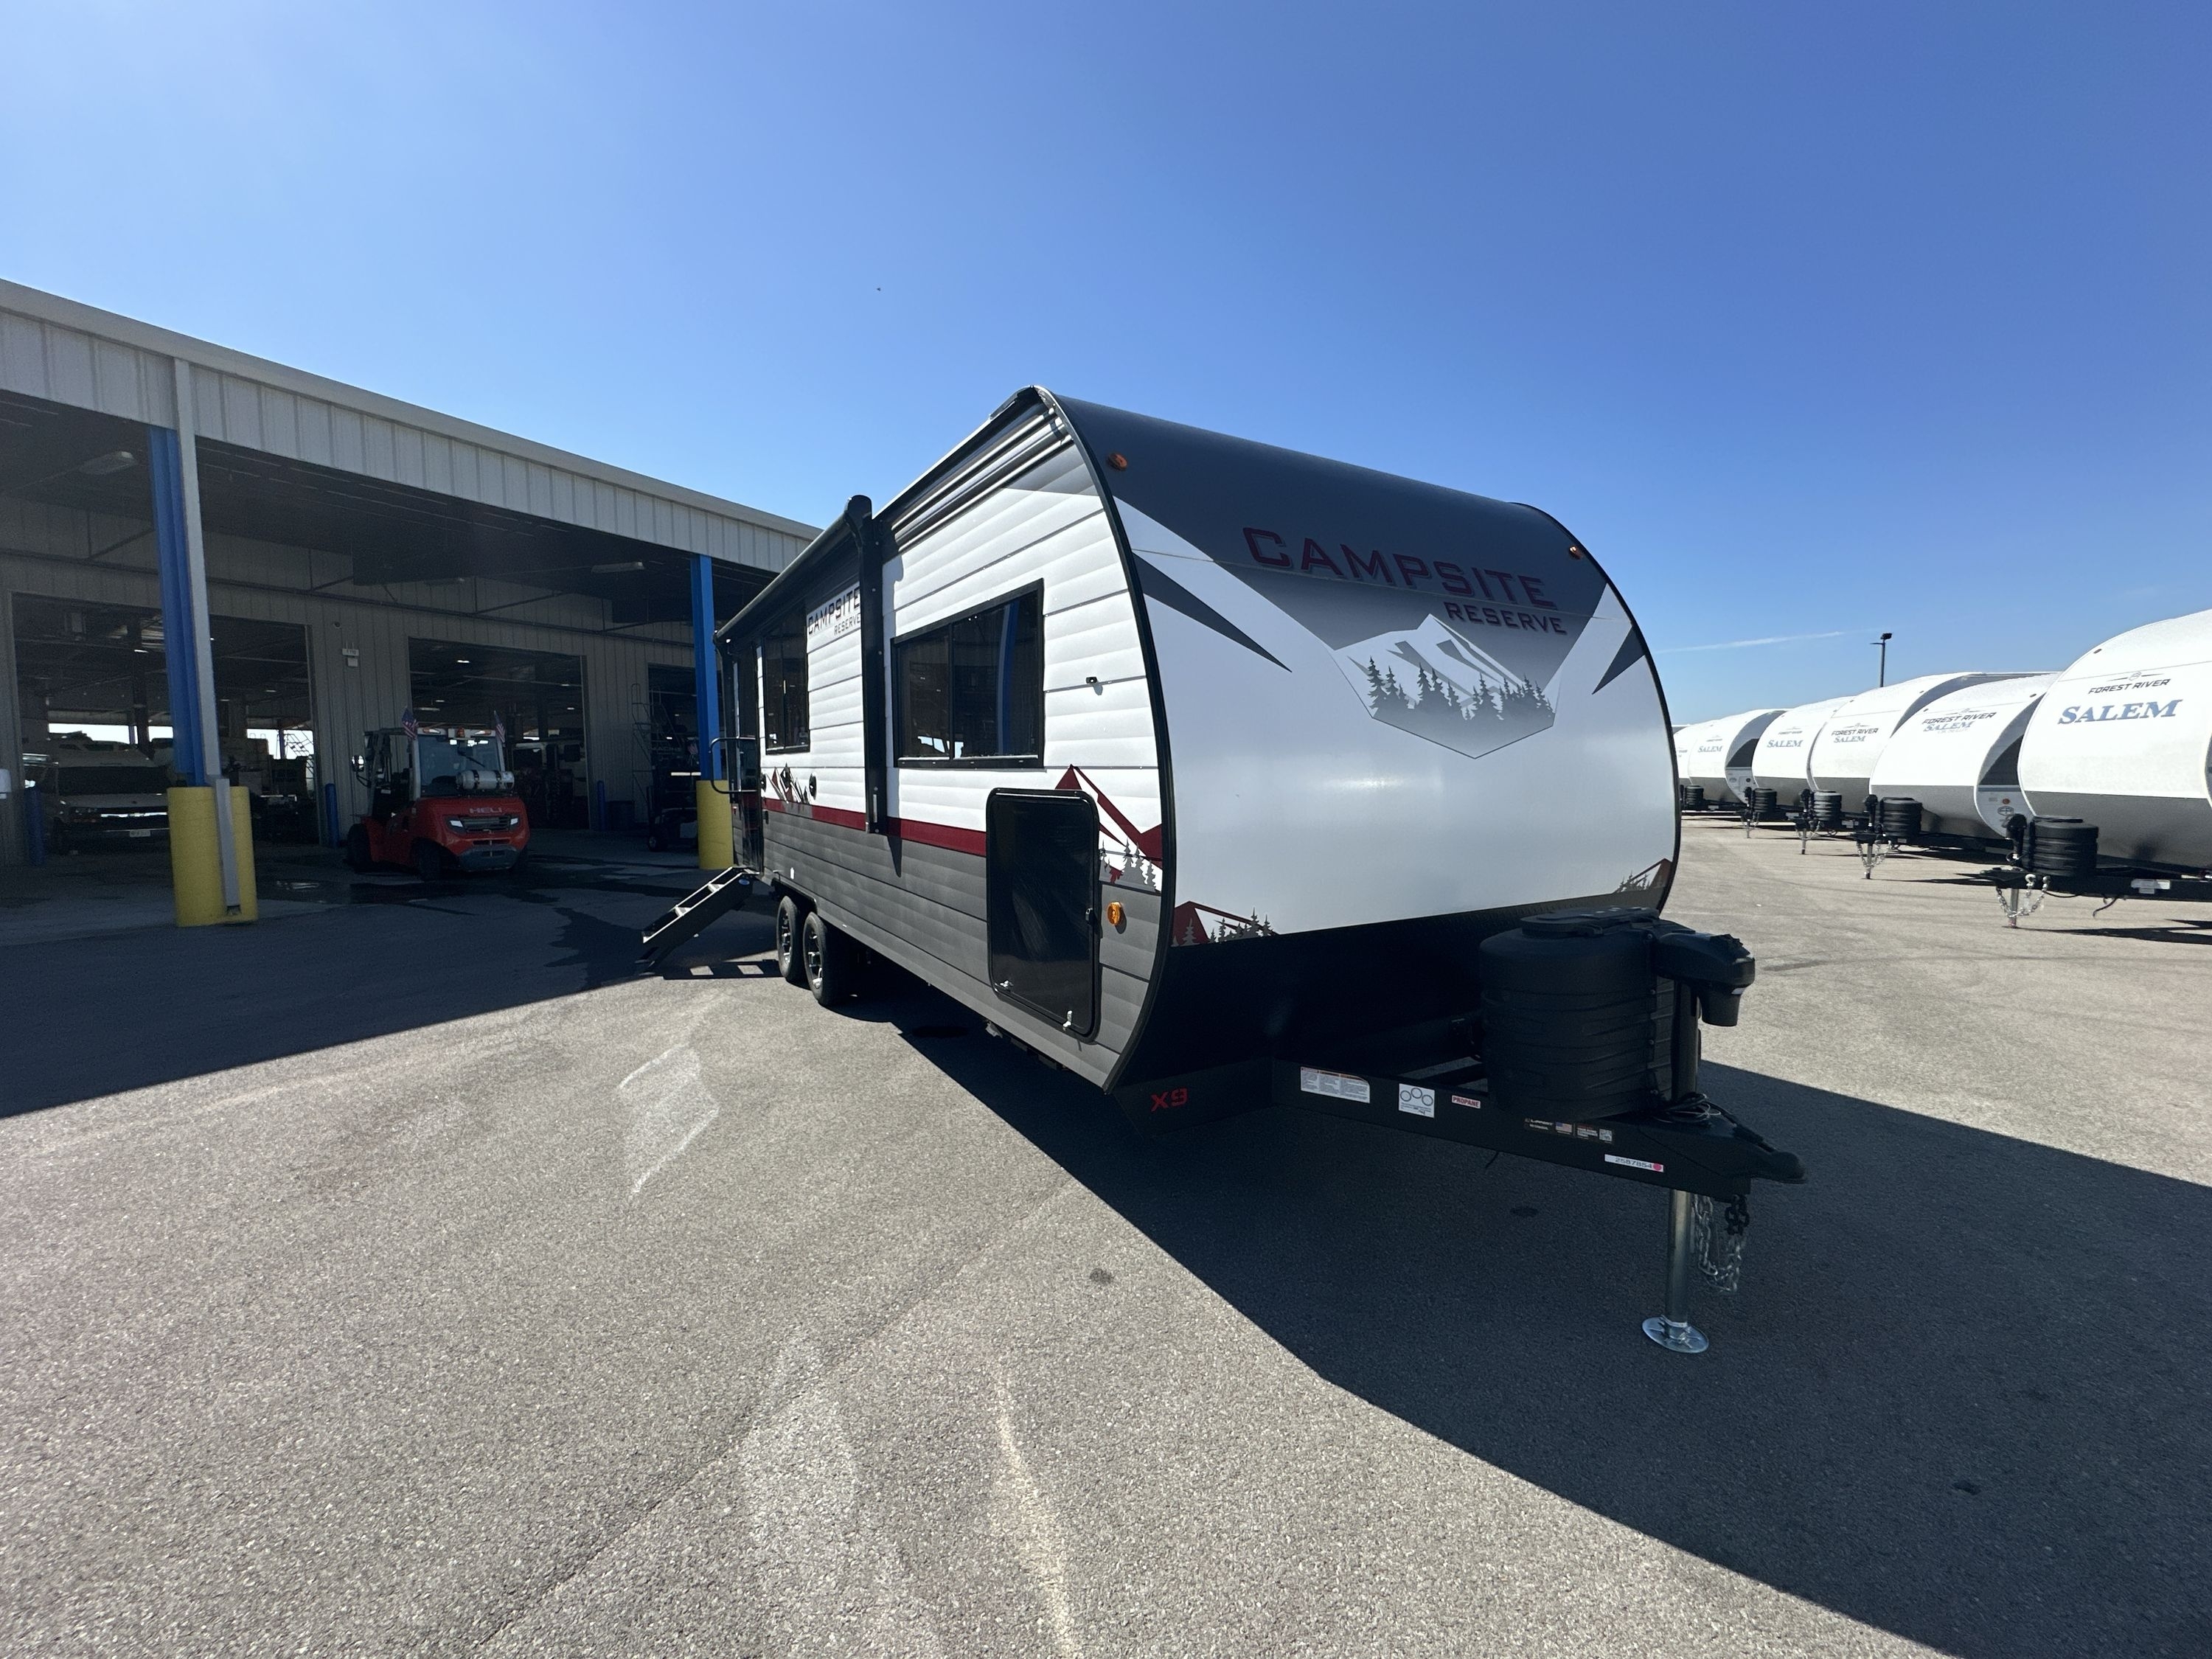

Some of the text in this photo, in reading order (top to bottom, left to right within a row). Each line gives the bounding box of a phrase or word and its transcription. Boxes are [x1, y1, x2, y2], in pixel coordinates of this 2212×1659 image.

[1242, 526, 1557, 611] CAMPSITE
[808, 585, 860, 635] CAMPSITE
[1442, 601, 1568, 636] RESERVE
[834, 612, 861, 635] RESERVE
[2088, 678, 2171, 695] FOREST RIVER
[1921, 712, 1997, 725] FOREST RIVER
[2057, 699, 2183, 725] SALEM
[1923, 721, 1975, 732] SALEM
[1767, 740, 1804, 748] SALEM
[1150, 1088, 1188, 1112] X9
[1453, 1096, 1480, 1107] PROPANE
